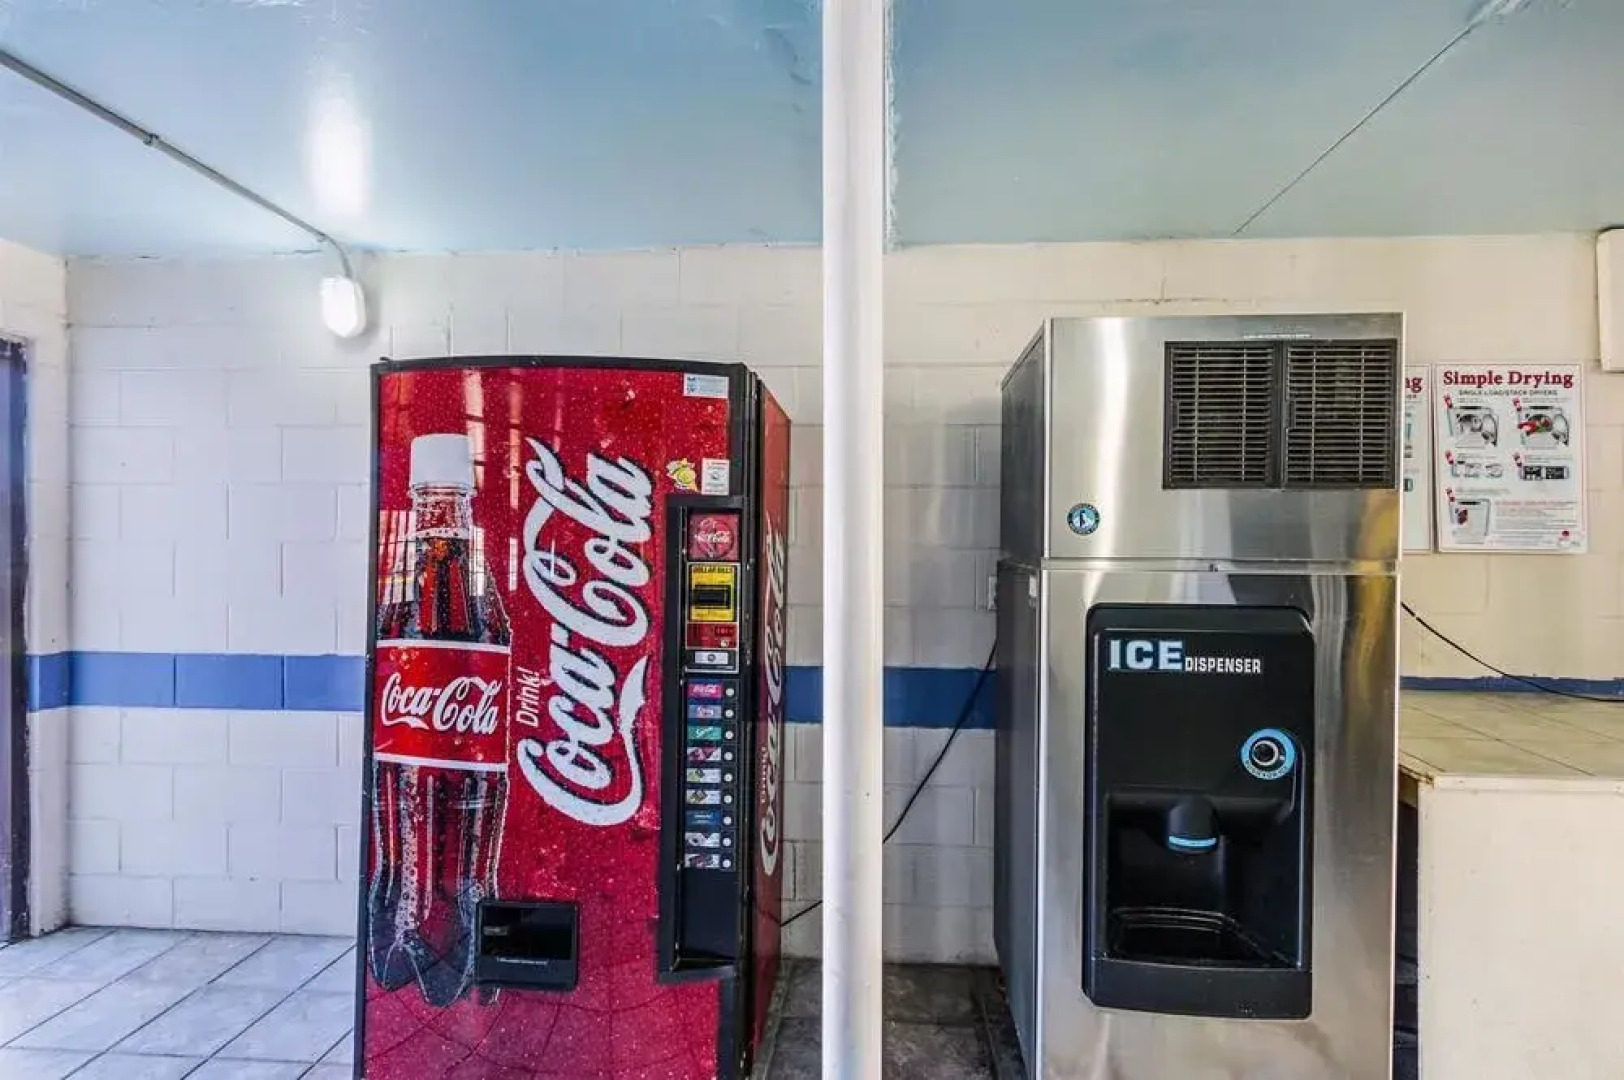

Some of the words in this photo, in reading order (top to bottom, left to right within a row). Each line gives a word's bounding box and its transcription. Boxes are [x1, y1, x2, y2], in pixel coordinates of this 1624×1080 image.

[1443, 370, 1503, 388] Simple
[1507, 371, 1574, 388] Drying
[516, 436, 655, 827] Coca-Cola
[1107, 639, 1184, 670] ICE
[1185, 657, 1262, 674] DISPENSER
[381, 672, 503, 735] Coca-Cola
[515, 666, 540, 729] Drink!
